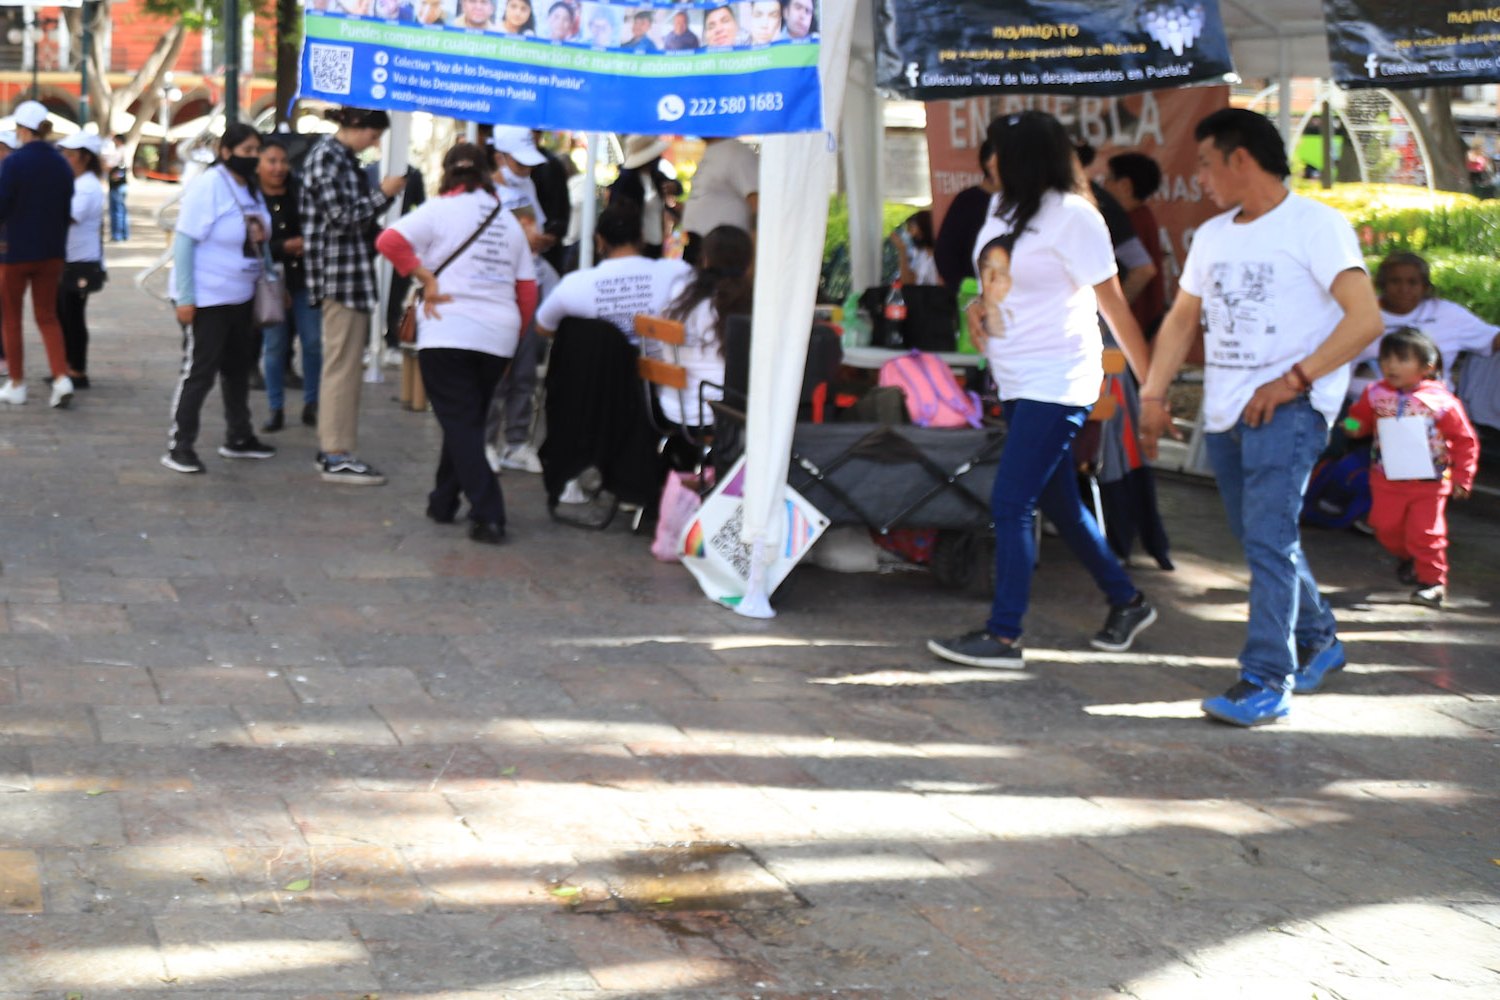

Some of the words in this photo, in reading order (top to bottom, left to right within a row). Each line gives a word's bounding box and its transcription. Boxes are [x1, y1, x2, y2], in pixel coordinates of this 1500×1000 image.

[340, 21, 382, 42] Puedes
[384, 26, 441, 49] compartir
[442, 34, 497, 57] cualquier
[499, 42, 571, 65] información
[574, 51, 590, 67] de
[640, 56, 693, 73] anónima
[695, 59, 716, 71] con
[393, 55, 430, 72] Colectivo
[452, 63, 463, 76] de
[464, 64, 476, 77] los
[478, 67, 537, 86] Desaparecidos
[539, 75, 550, 86] en
[922, 72, 972, 87] Colectivo
[1003, 71, 1018, 85] de
[1020, 70, 1039, 85] los
[1040, 68, 1125, 86] desaparecidos
[1127, 69, 1143, 81] en
[393, 72, 408, 85] Voz
[409, 73, 419, 86] de
[420, 75, 431, 88] los
[433, 78, 493, 97] Desaparecidos
[494, 86, 505, 97] en
[506, 86, 536, 101] Puebla
[690, 98, 716, 116] 222
[718, 96, 746, 114] 580
[749, 92, 784, 111] 1683
